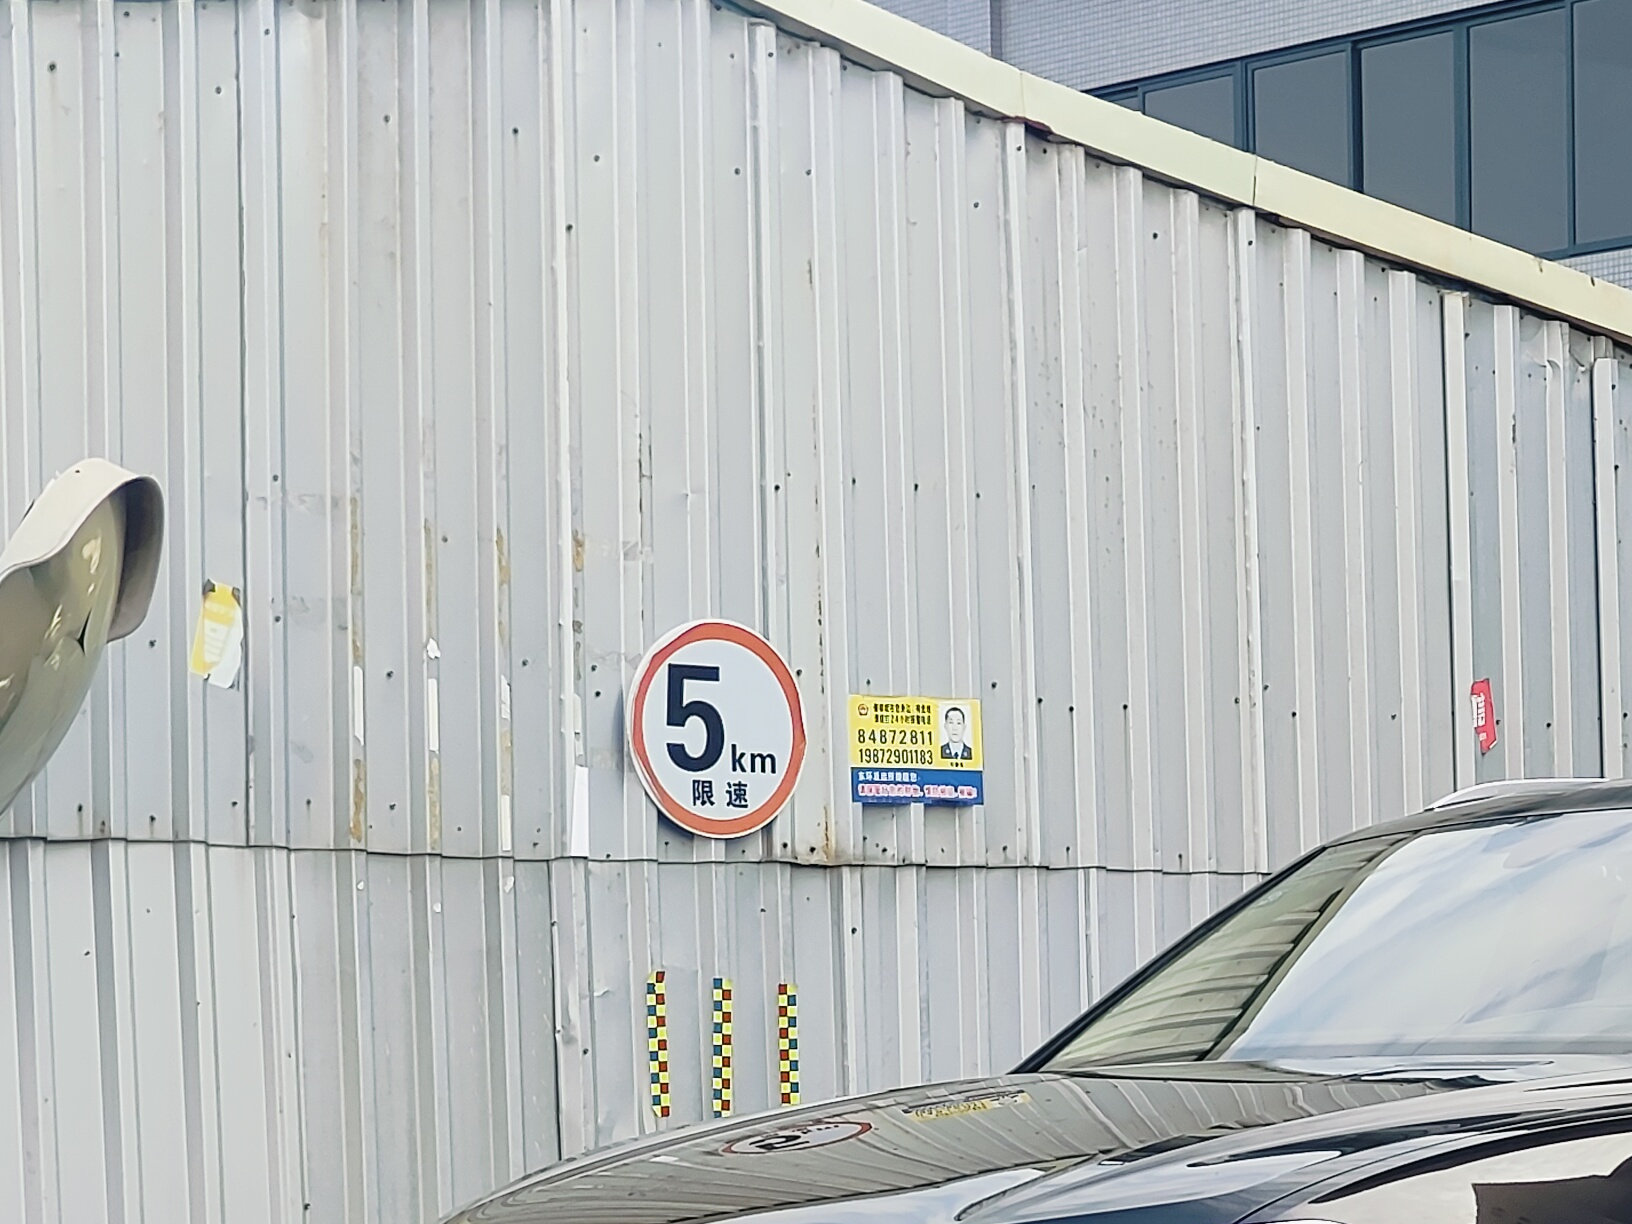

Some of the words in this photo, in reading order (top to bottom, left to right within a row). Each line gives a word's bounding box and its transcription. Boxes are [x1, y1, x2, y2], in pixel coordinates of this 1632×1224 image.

[666, 663, 725, 772] 5
[731, 744, 776, 774] km
[858, 729, 933, 745] 84872811
[692, 780, 749, 808] 限速
